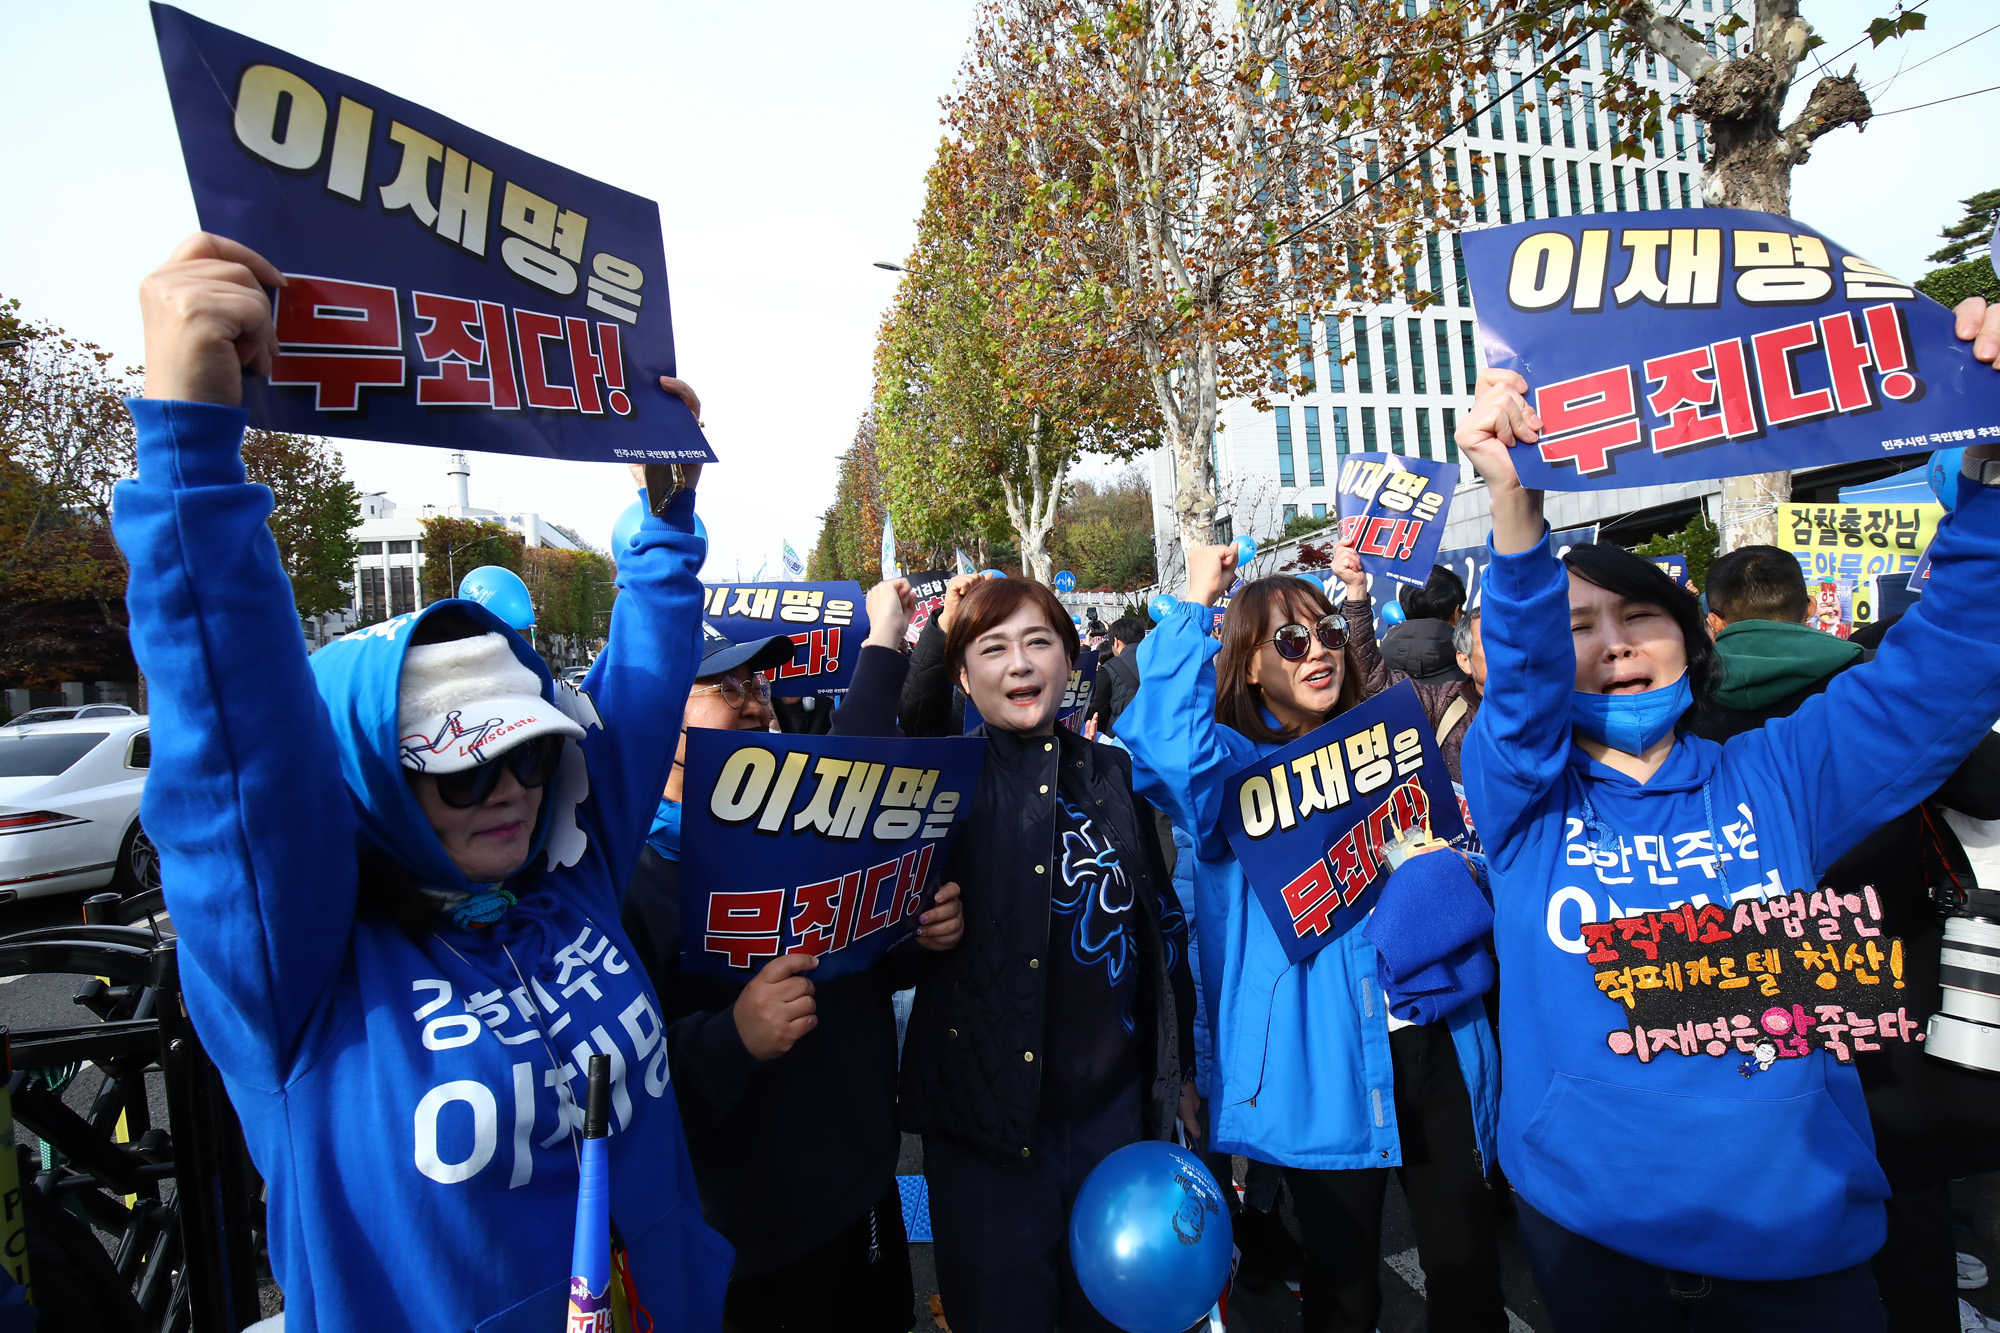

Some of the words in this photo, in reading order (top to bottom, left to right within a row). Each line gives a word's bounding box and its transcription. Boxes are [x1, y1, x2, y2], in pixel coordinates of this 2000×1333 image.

[234, 64, 645, 326] 이재명은
[1508, 227, 1916, 308] 이재명은
[268, 273, 633, 416] 무죄다!
[1536, 302, 1917, 476] 무죄다!
[613, 448, 647, 459] 민주시민
[1881, 434, 1929, 451] 민주시민
[1929, 428, 1976, 444] 국민항쟁
[1977, 425, 2000, 438] 추진
[1338, 459, 1444, 522] 이재명은
[1791, 508, 1920, 549] 검찰총장님
[1338, 514, 1424, 560] 죄다!
[703, 587, 854, 626] 이재명은
[710, 746, 961, 840] 이재명은
[1239, 721, 1425, 838] 이재명은
[1280, 773, 1430, 939] 무죄다!
[704, 842, 936, 968] 무죄다!
[1794, 940, 1906, 990] 청산!
[413, 991, 671, 1190] 이재명
